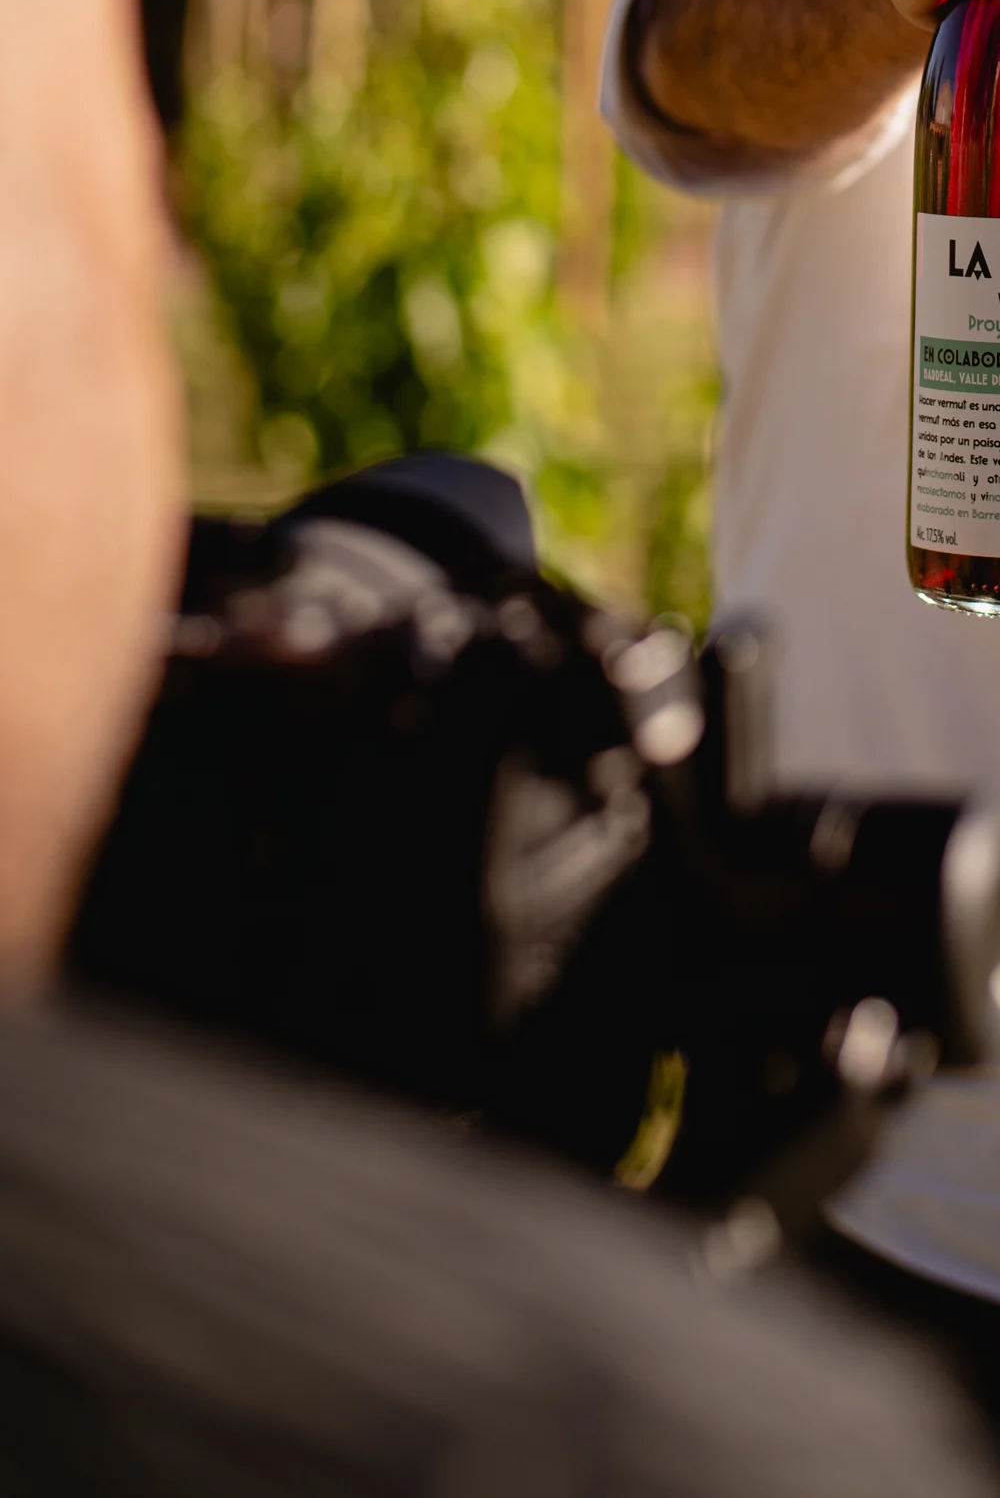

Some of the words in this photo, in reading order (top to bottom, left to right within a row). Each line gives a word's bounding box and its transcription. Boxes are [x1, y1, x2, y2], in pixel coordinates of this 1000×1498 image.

[949, 239, 992, 281] LA
[924, 346, 935, 363] EN
[959, 371, 988, 385] VALLE
[937, 399, 967, 410] vermut
[969, 402, 980, 411] es
[919, 414, 940, 425] vermut
[942, 417, 960, 427] más
[963, 420, 975, 428] en
[979, 421, 996, 430] esa
[940, 435, 955, 446] por
[957, 438, 970, 446] un
[918, 448, 925, 458] de
[927, 450, 936, 460] los
[970, 455, 989, 465] Este
[973, 475, 979, 487] y
[970, 493, 976, 504] y
[957, 509, 969, 518] en
